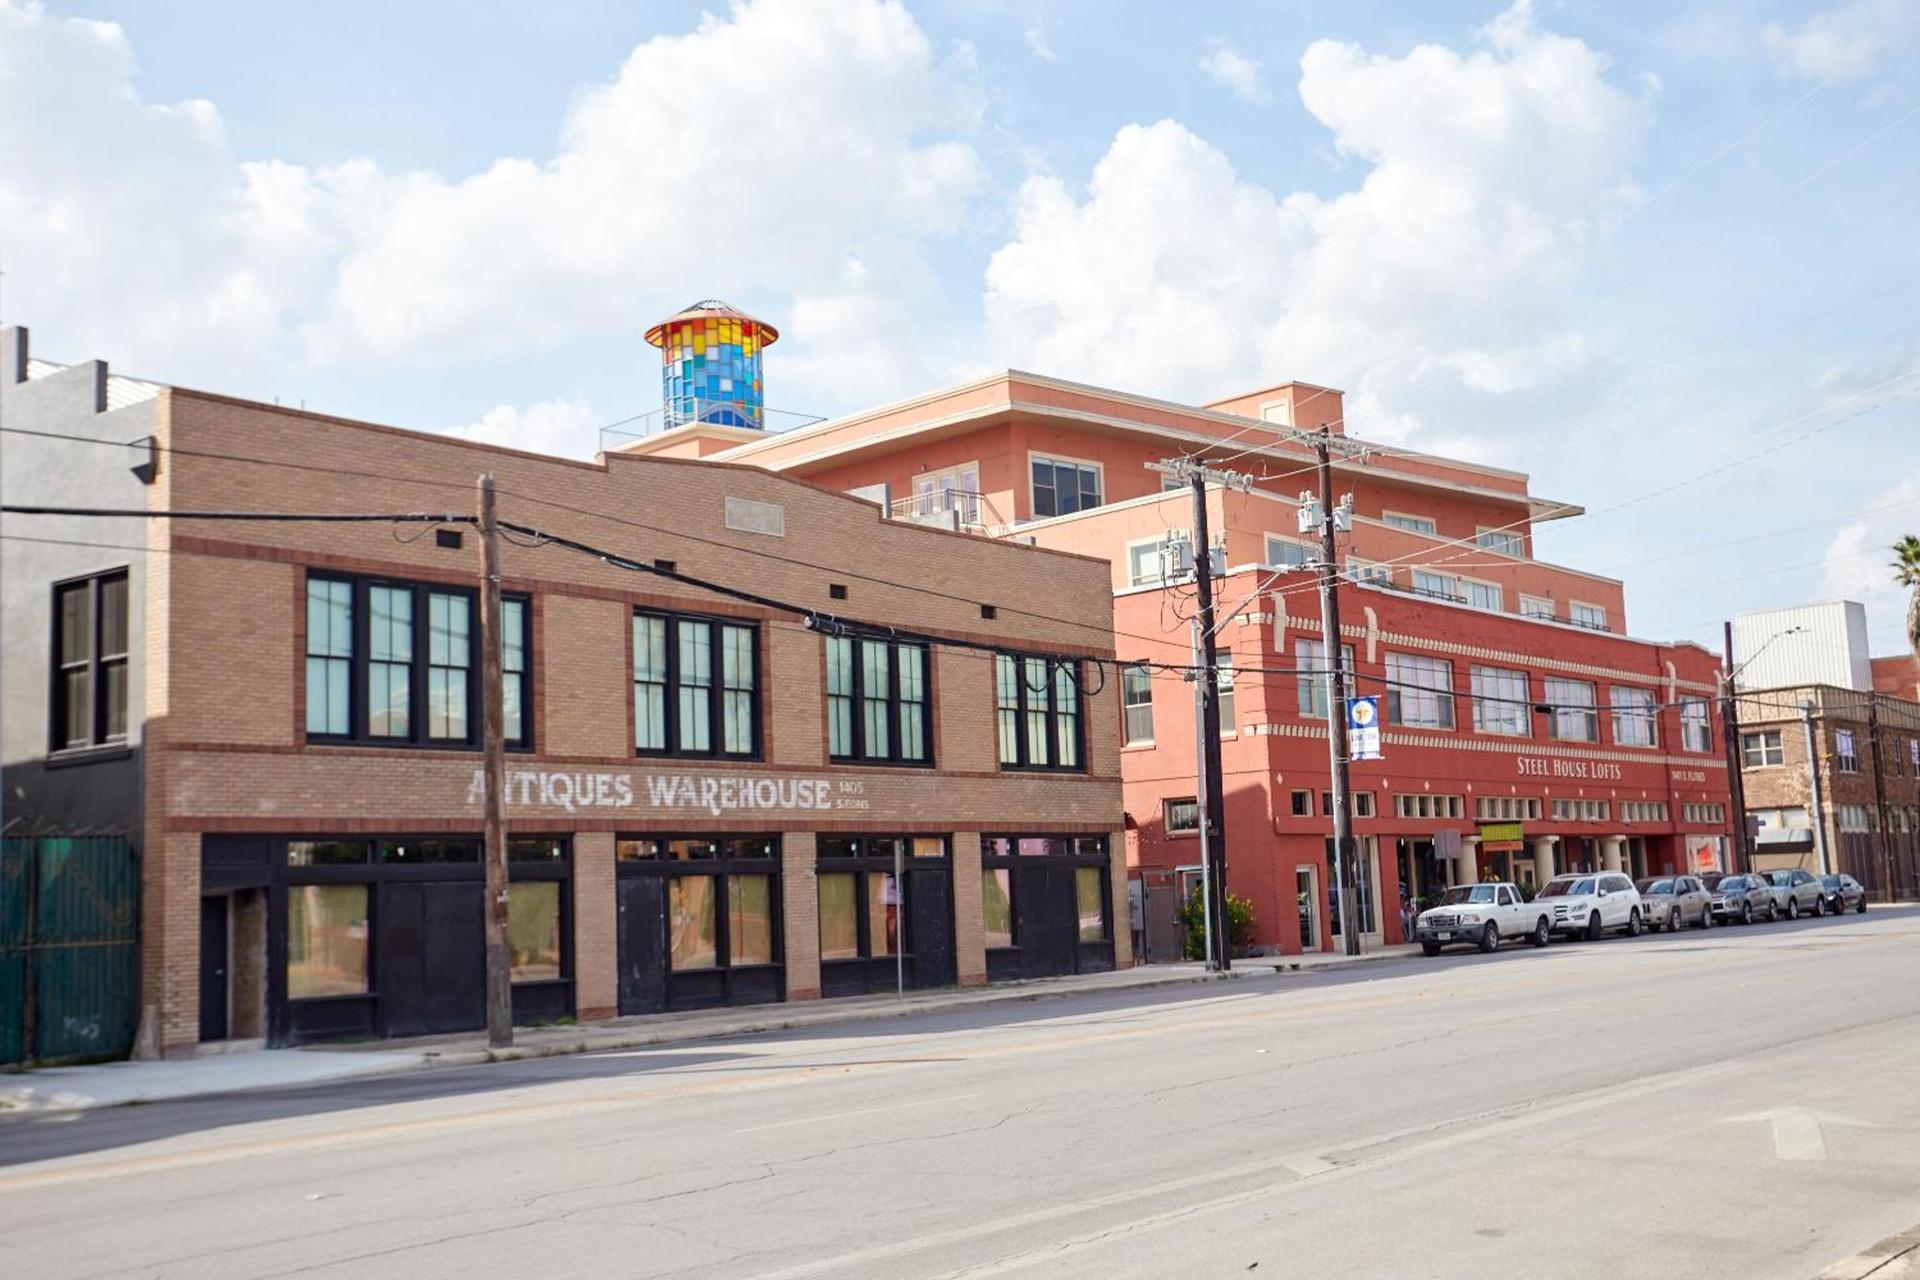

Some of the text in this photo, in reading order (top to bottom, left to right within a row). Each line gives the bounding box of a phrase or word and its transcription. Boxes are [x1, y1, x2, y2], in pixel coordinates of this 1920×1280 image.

[1517, 756, 1621, 780] STEEL HOUSE LOFTS
[646, 774, 832, 816] WAREHOUSE
[839, 781, 864, 795] 1405
